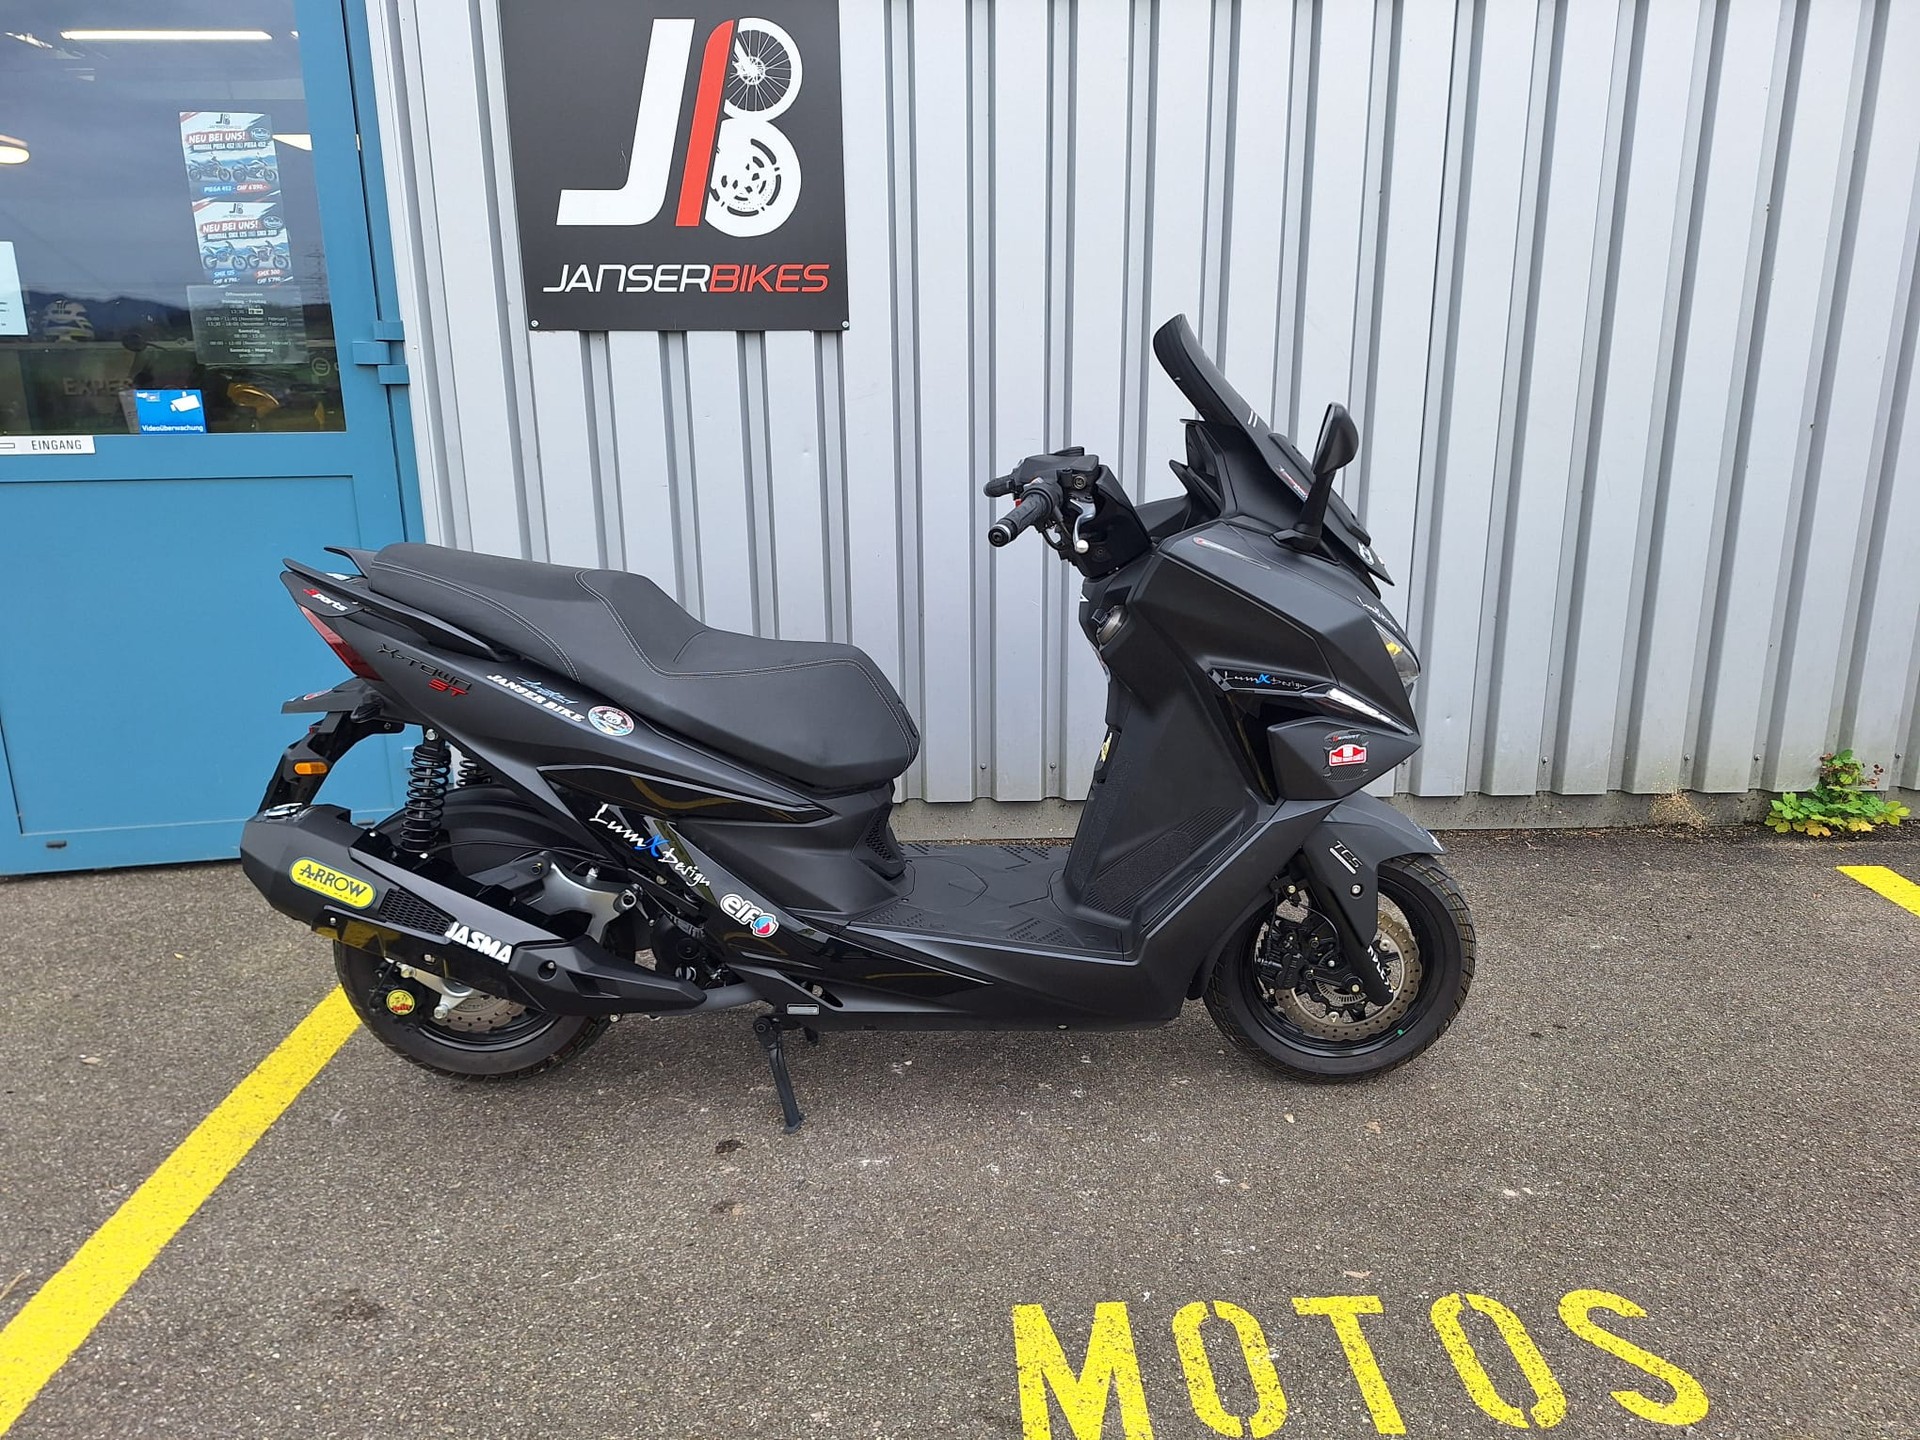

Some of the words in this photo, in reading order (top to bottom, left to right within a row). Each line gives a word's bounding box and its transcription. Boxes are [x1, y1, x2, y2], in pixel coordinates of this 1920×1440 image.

[188, 134, 207, 144] NEU
[208, 133, 223, 143] BEI
[225, 131, 246, 142] UNS!
[202, 224, 220, 234] NEU
[222, 222, 236, 232] BEI
[238, 220, 258, 231] UNS!
[542, 263, 830, 293] JANSERBIKES
[141, 424, 204, 433] Videoüberwachung
[31, 439, 82, 451] EINGANG
[427, 678, 469, 698] ST
[486, 673, 547, 705] JANSER
[541, 699, 586, 723] BIKE
[1332, 840, 1363, 869] TCS
[300, 863, 368, 898] ARROW
[720, 893, 761, 927] elf
[444, 922, 515, 965] JASMA
[1012, 1289, 1710, 1440] MOTOS
